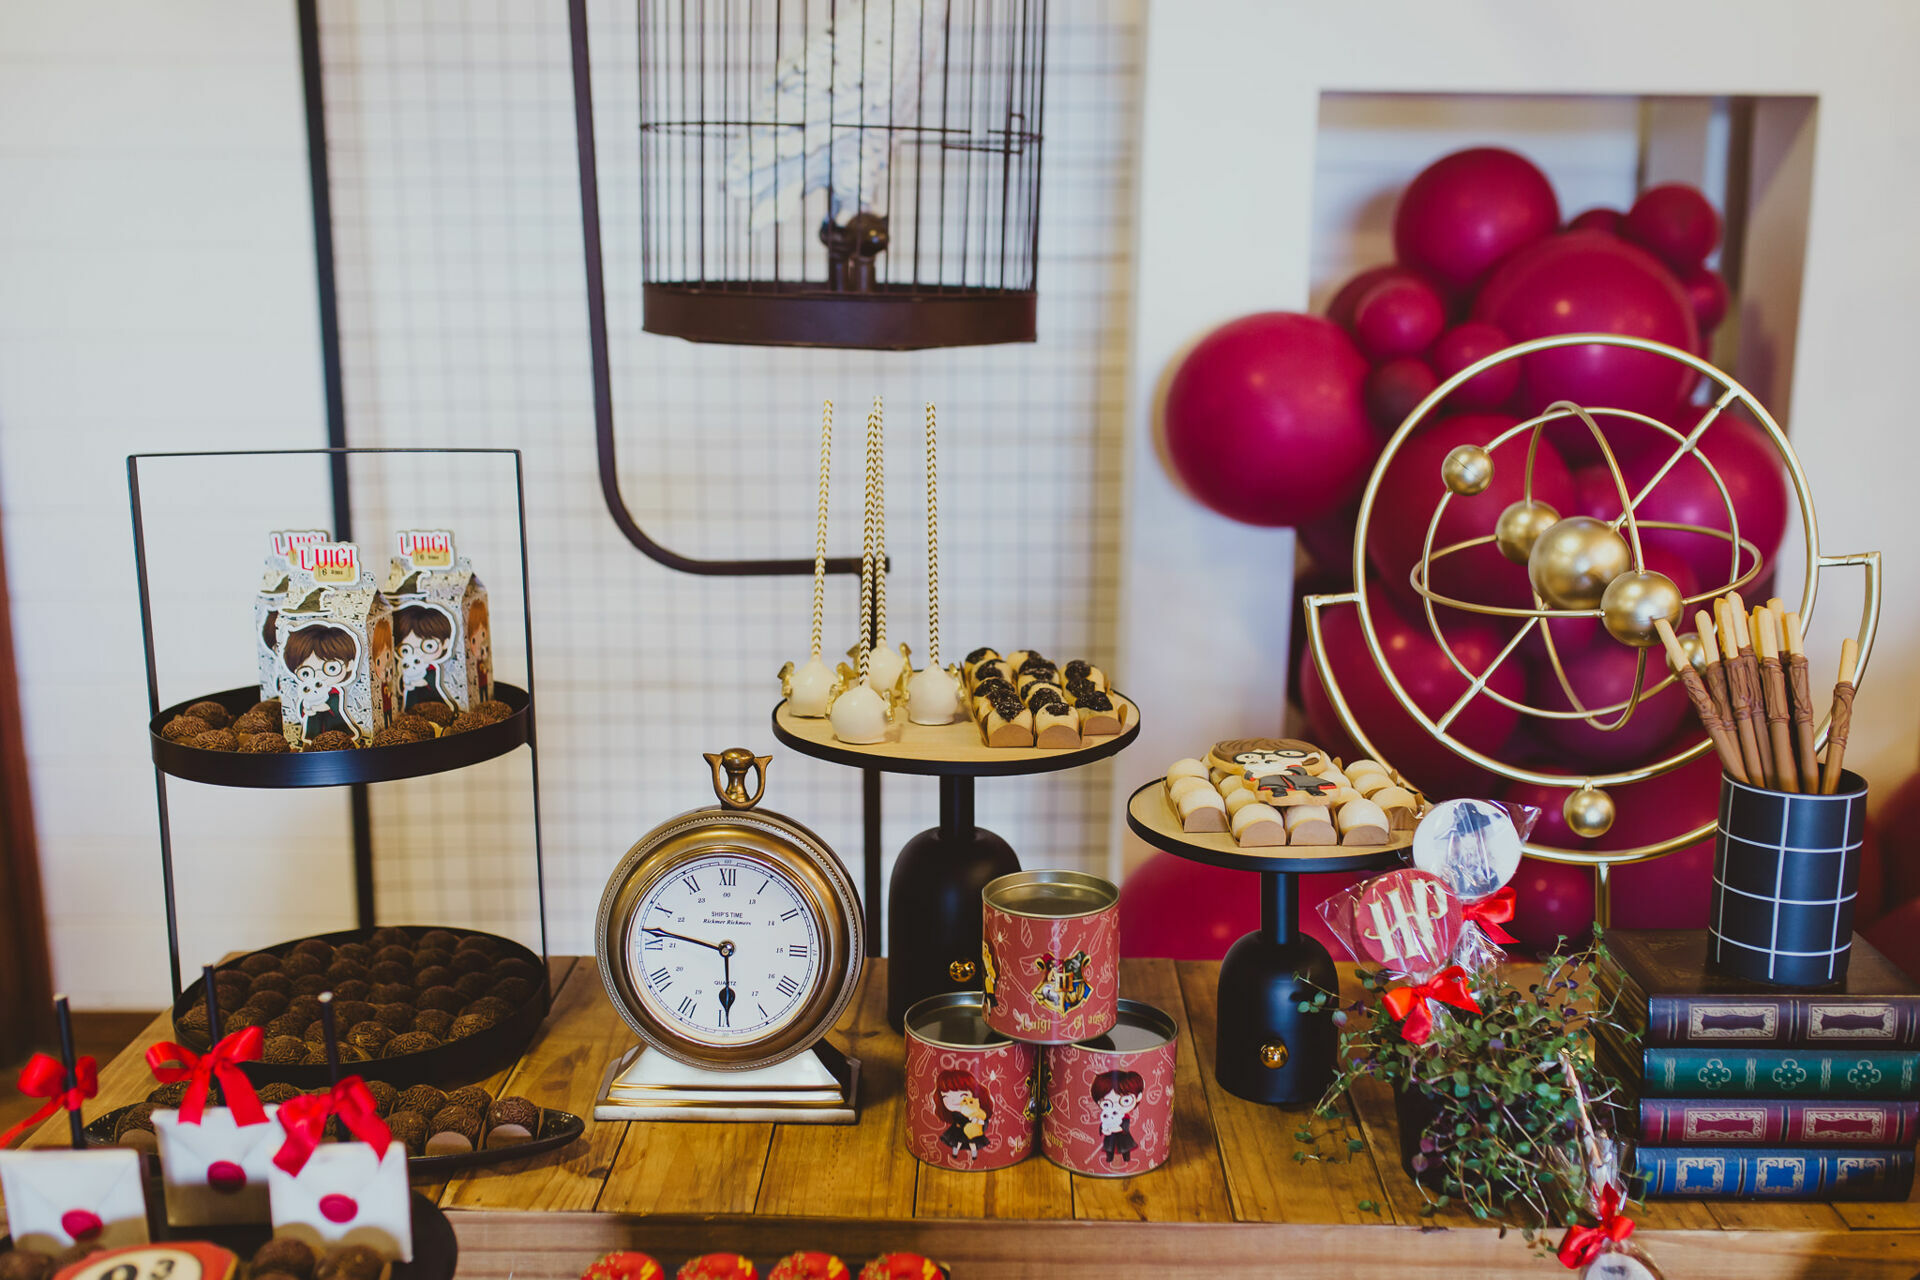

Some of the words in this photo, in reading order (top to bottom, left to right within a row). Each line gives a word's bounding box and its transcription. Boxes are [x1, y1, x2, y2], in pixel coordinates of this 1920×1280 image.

[400, 534, 449, 556] LUIGI
[301, 548, 353, 571] LUIGI
[683, 875, 701, 895] XI
[719, 868, 737, 886] XII
[655, 902, 673, 918] X
[780, 908, 799, 922] II
[789, 945, 807, 958] III
[650, 967, 673, 993] VIII
[677, 996, 697, 1019] VII
